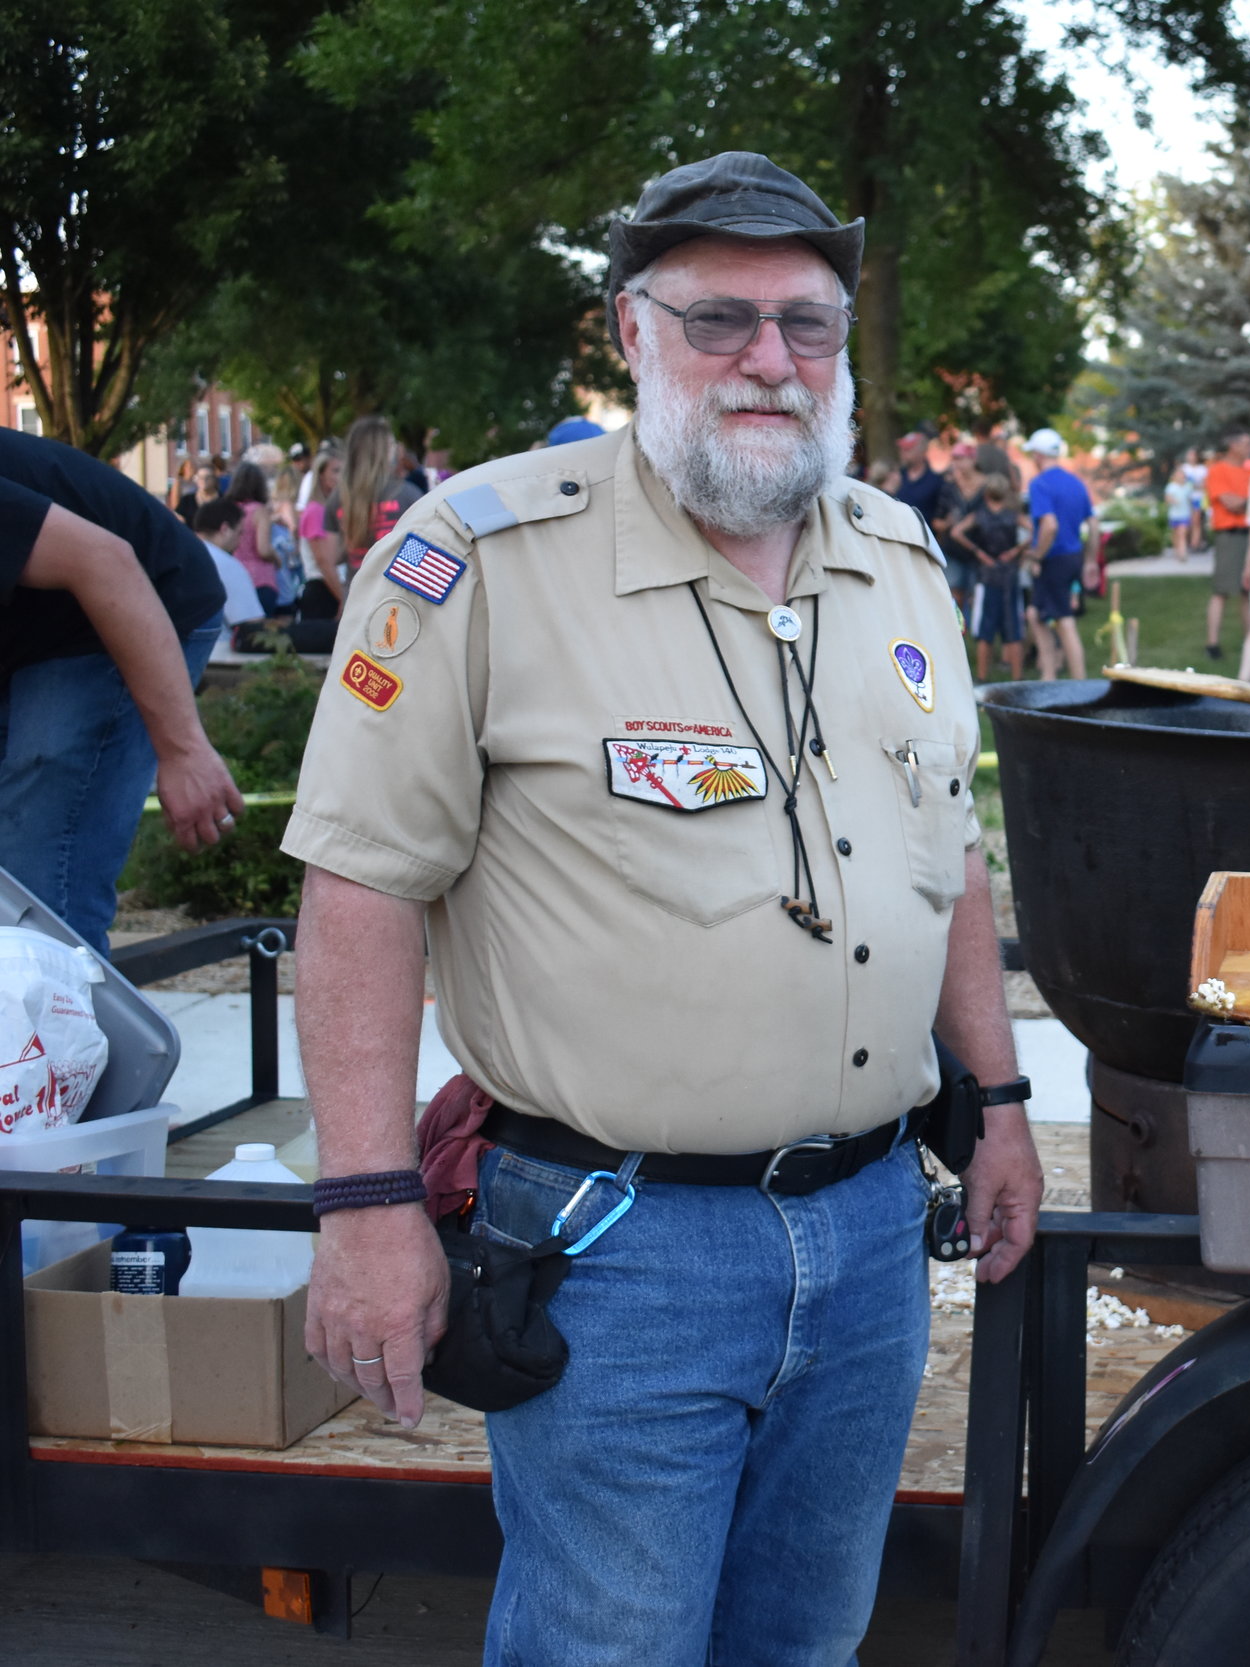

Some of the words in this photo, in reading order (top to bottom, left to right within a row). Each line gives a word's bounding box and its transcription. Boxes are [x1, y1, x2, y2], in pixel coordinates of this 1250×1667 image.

[368, 670, 392, 689] QUALITY
[368, 679, 383, 692] UNIT
[625, 720, 644, 732] BOY
[646, 720, 684, 733] SCOUTS
[693, 724, 733, 738] AMERICA
[693, 745, 720, 755] Lodge
